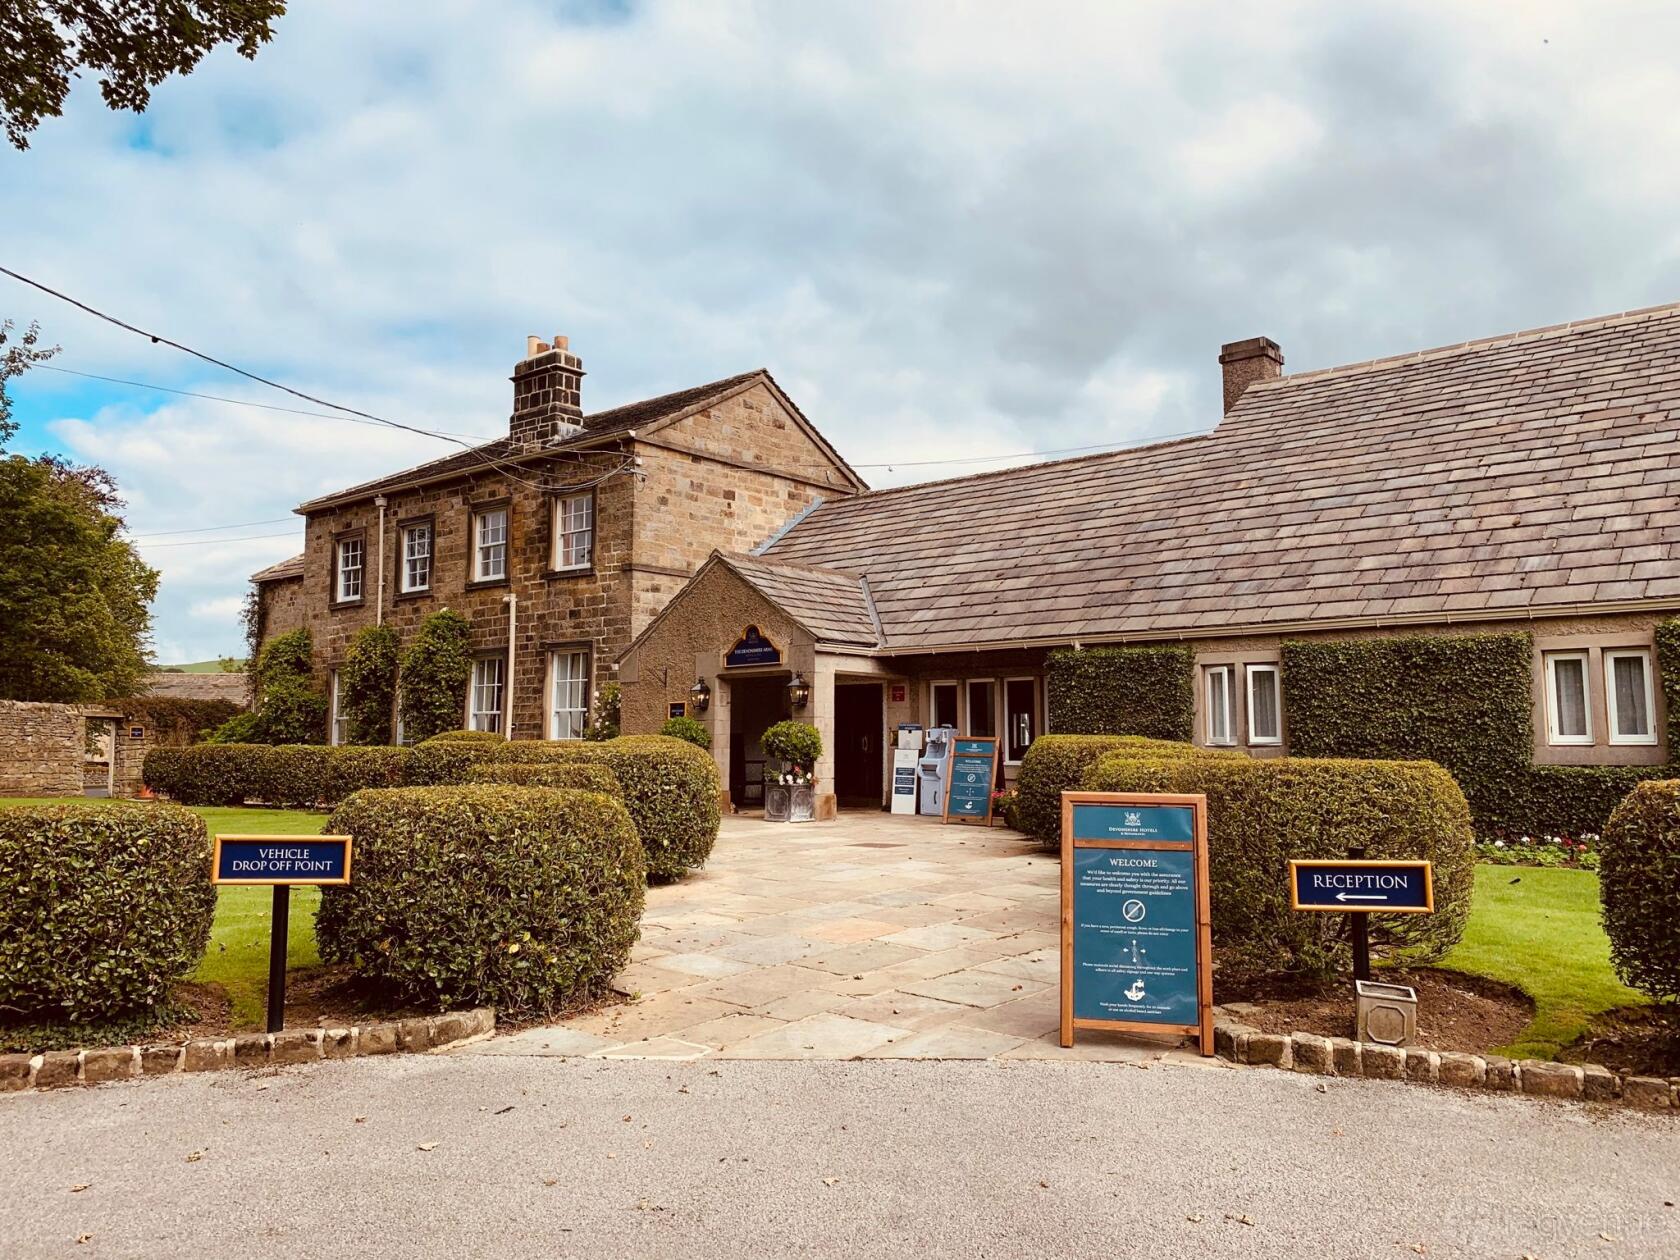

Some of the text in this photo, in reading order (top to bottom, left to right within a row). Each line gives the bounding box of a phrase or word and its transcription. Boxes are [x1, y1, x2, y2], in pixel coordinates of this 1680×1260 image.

[259, 848, 310, 859] VEHICLE
[232, 860, 333, 871] DROP OFF POINT
[1109, 858, 1158, 867] WELCOME
[1313, 874, 1408, 889] RECEPTION
